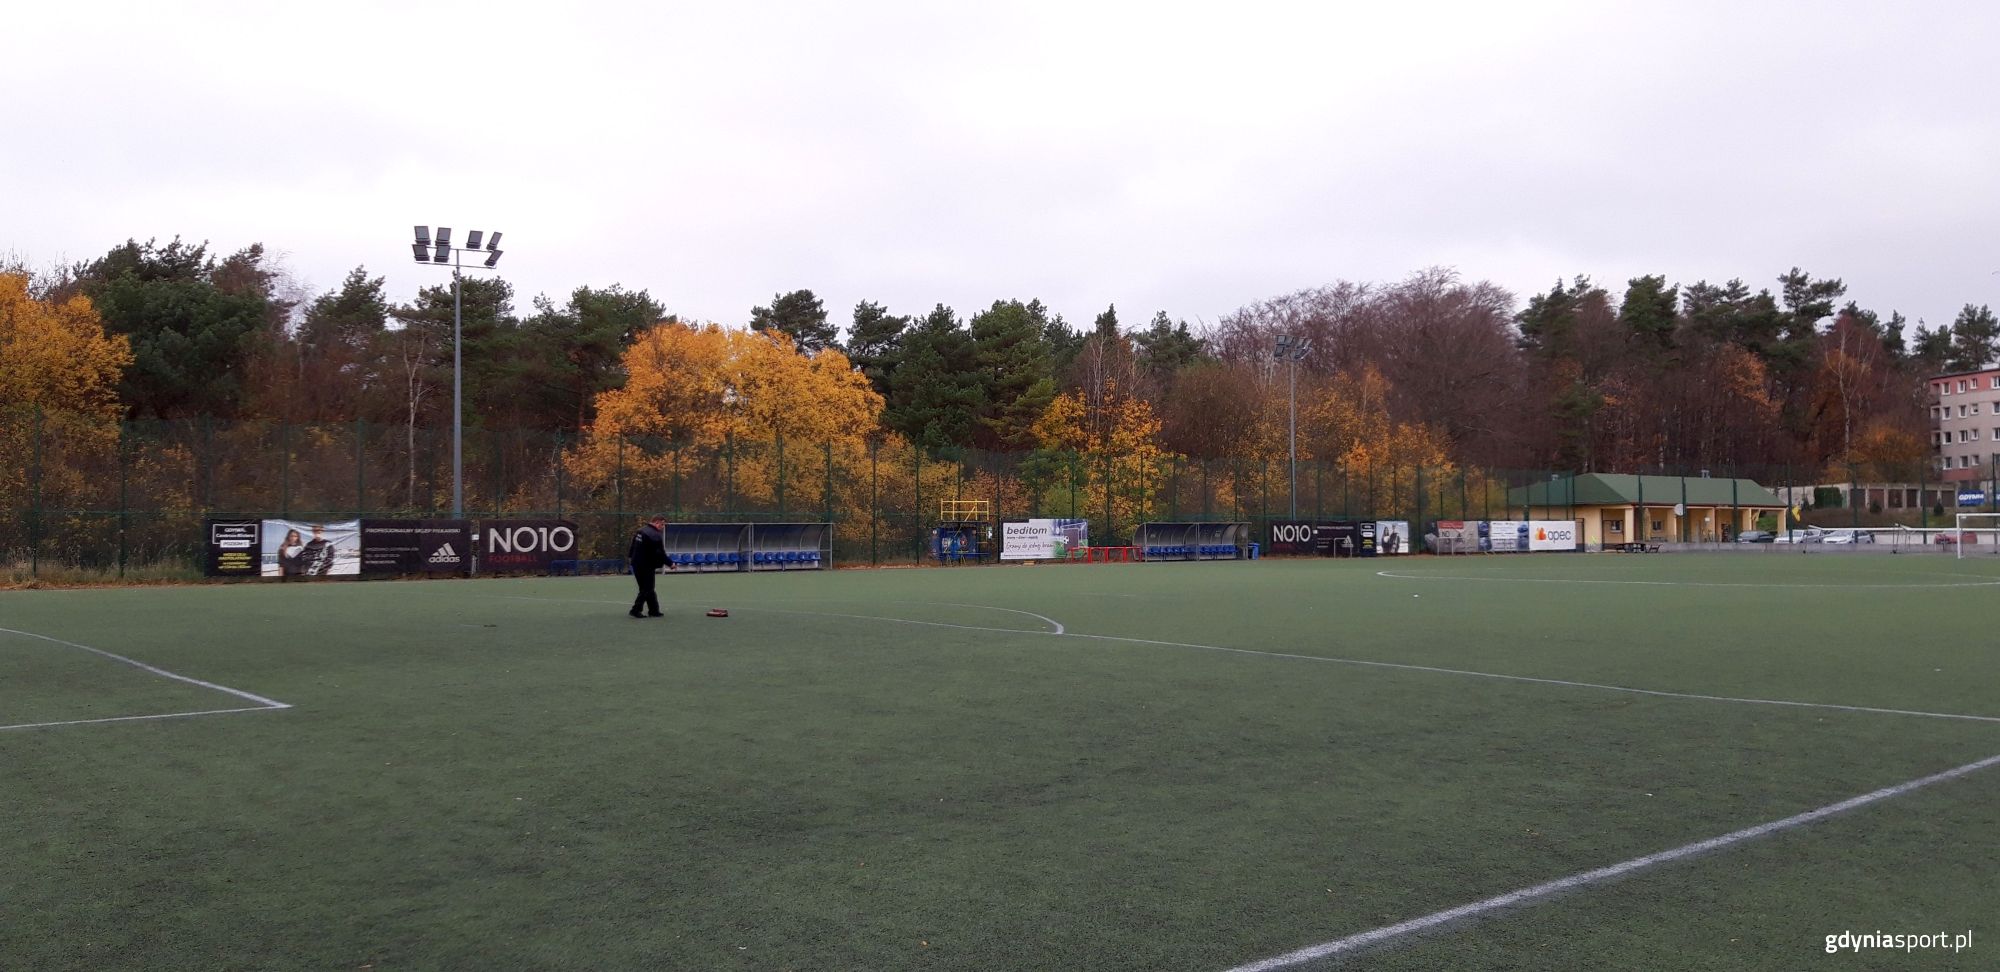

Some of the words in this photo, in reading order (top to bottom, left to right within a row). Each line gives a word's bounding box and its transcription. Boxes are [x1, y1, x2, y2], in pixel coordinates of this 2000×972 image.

[1006, 526, 1048, 535] beditom
[1273, 525, 1311, 542] NO10
[1547, 529, 1572, 543] opec
[489, 526, 574, 553] NO10
[428, 555, 461, 563] adidas
[488, 554, 538, 563] FOOTBALL
